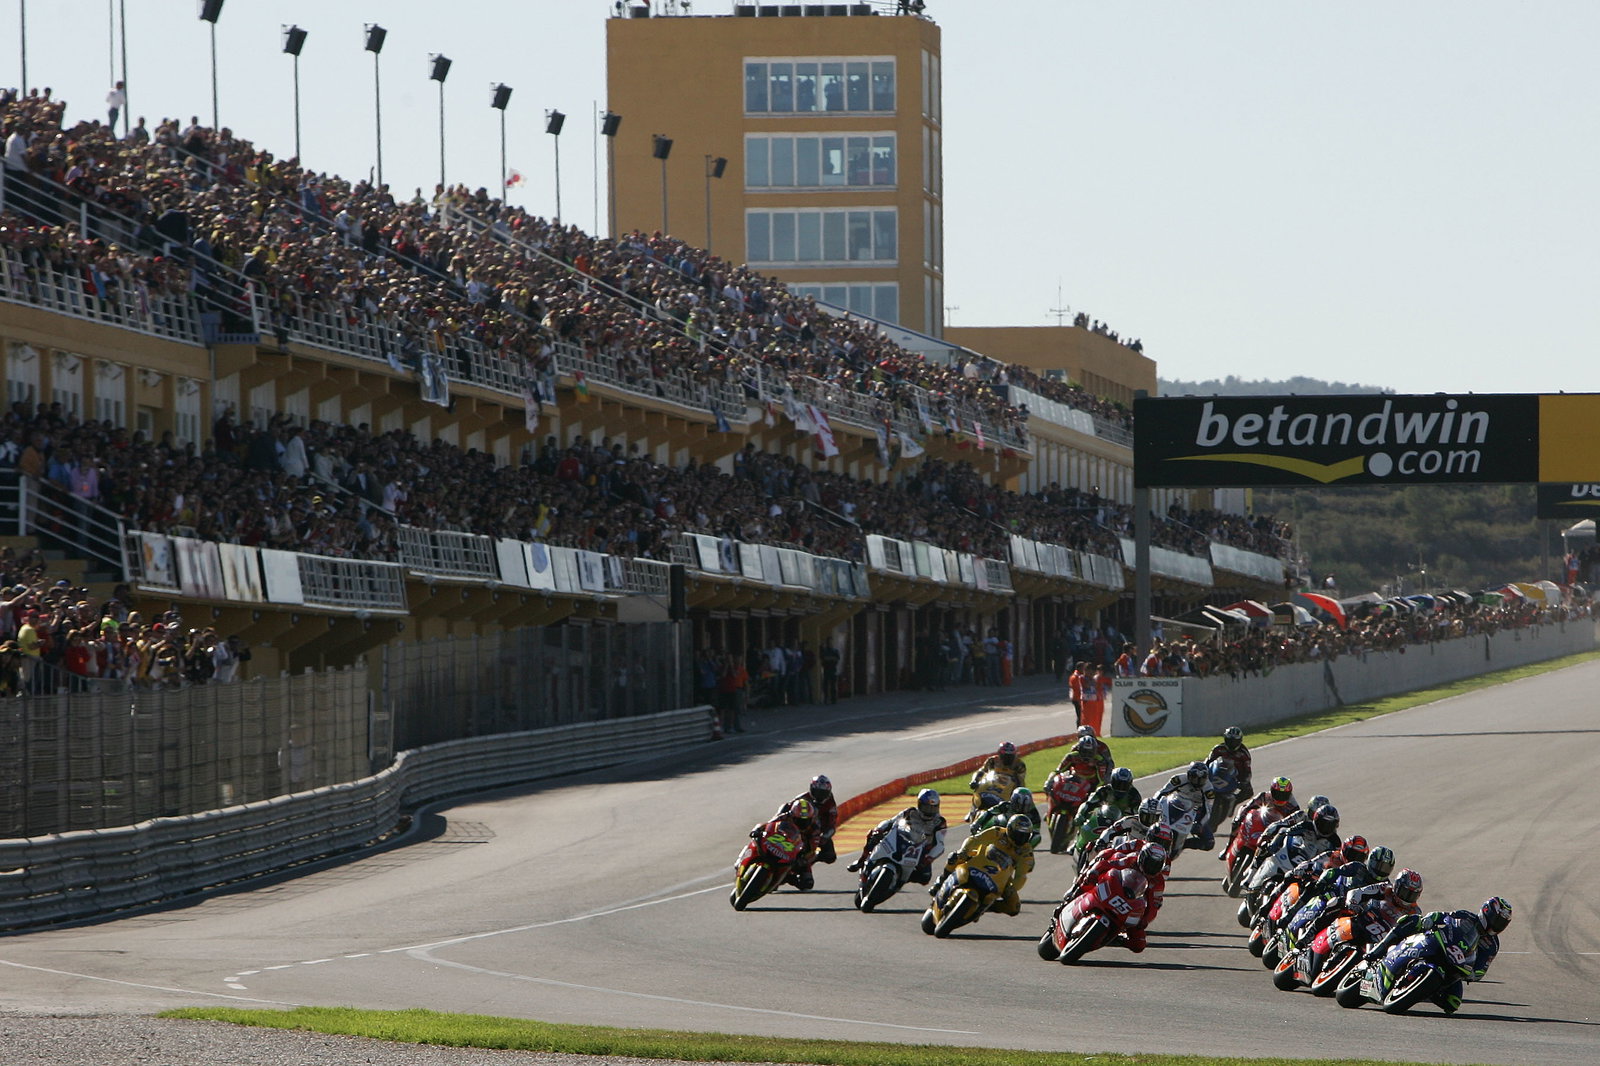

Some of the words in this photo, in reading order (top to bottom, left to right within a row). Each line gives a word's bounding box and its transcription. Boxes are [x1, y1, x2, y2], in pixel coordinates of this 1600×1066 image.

[1196, 399, 1490, 447] betandwin
[766, 833, 796, 852] 24
[970, 868, 995, 892] CAMEL
[1108, 895, 1133, 915] 65
